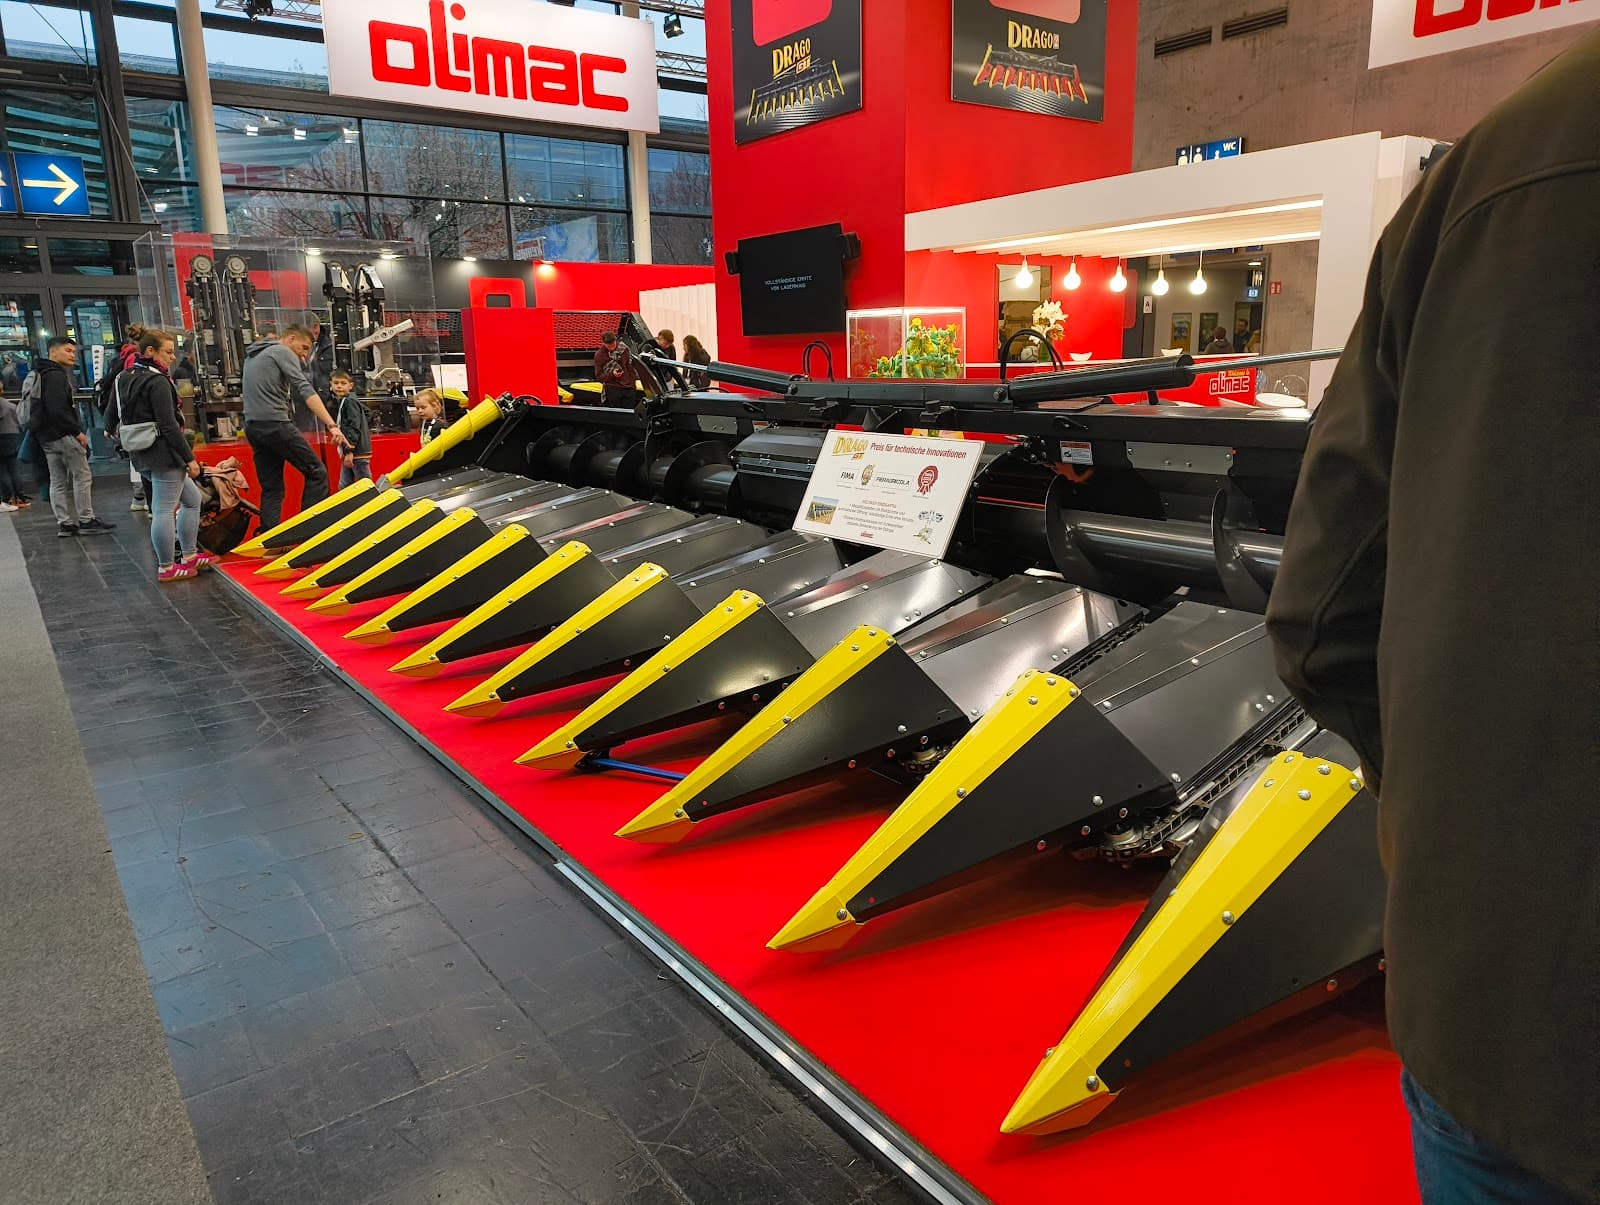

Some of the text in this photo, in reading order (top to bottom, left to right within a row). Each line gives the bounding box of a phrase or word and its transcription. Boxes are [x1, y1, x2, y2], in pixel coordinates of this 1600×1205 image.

[1008, 20, 1053, 48] DRAGO
[368, 0, 629, 113] olimac
[772, 38, 811, 76] DRAGO
[1223, 141, 1236, 151] WC
[832, 436, 868, 455] DRAGO
[870, 442, 967, 459] Preis für technische Innovationen
[840, 471, 855, 480] FIMA
